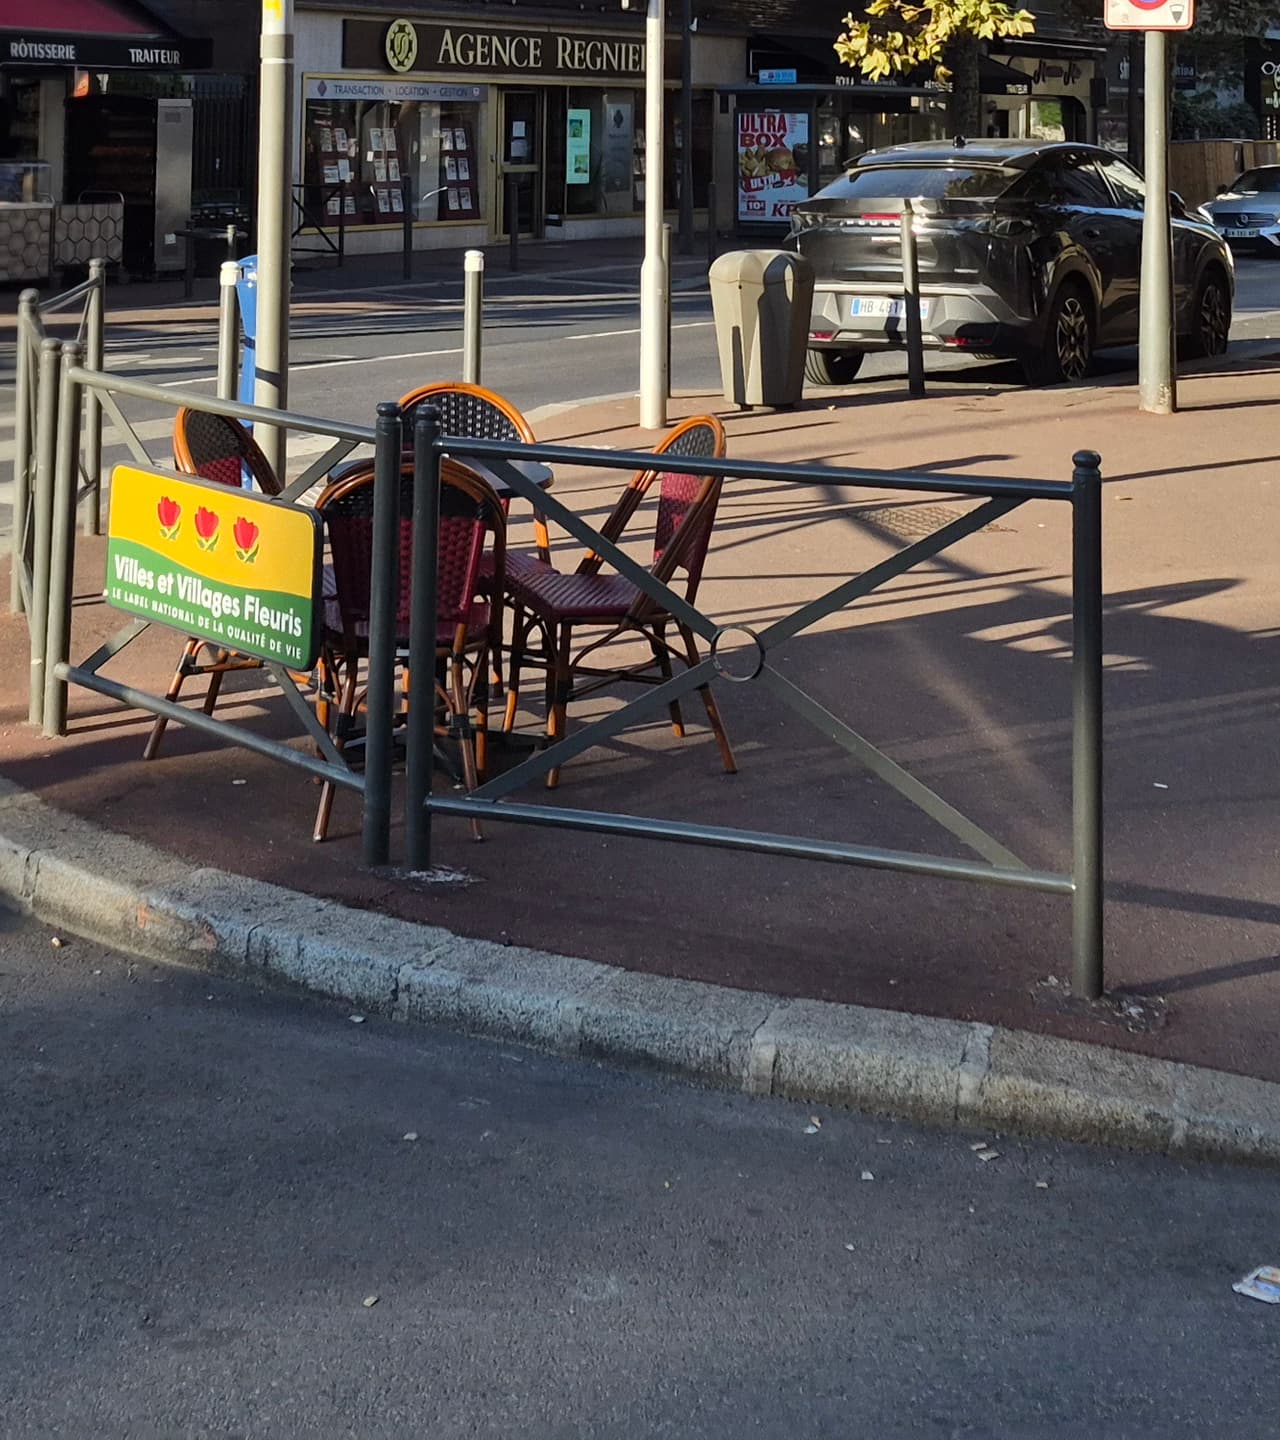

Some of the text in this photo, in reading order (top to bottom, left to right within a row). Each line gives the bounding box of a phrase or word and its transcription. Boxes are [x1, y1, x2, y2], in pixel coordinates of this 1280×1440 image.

[10, 38, 76, 60] RÔTISSERIE
[128, 47, 181, 65] TRAITEUR
[437, 28, 542, 69] AGENCE
[333, 84, 468, 98] TRANSACTION LOCATION GESTION
[740, 113, 787, 133] ULTRA
[739, 133, 787, 149] BOX
[771, 204, 797, 217] KF
[114, 554, 302, 637] Villes et Villages Fleuris
[112, 587, 302, 660] LE LABEL NATIONAL DE LA QUALITÉ DE VIE
